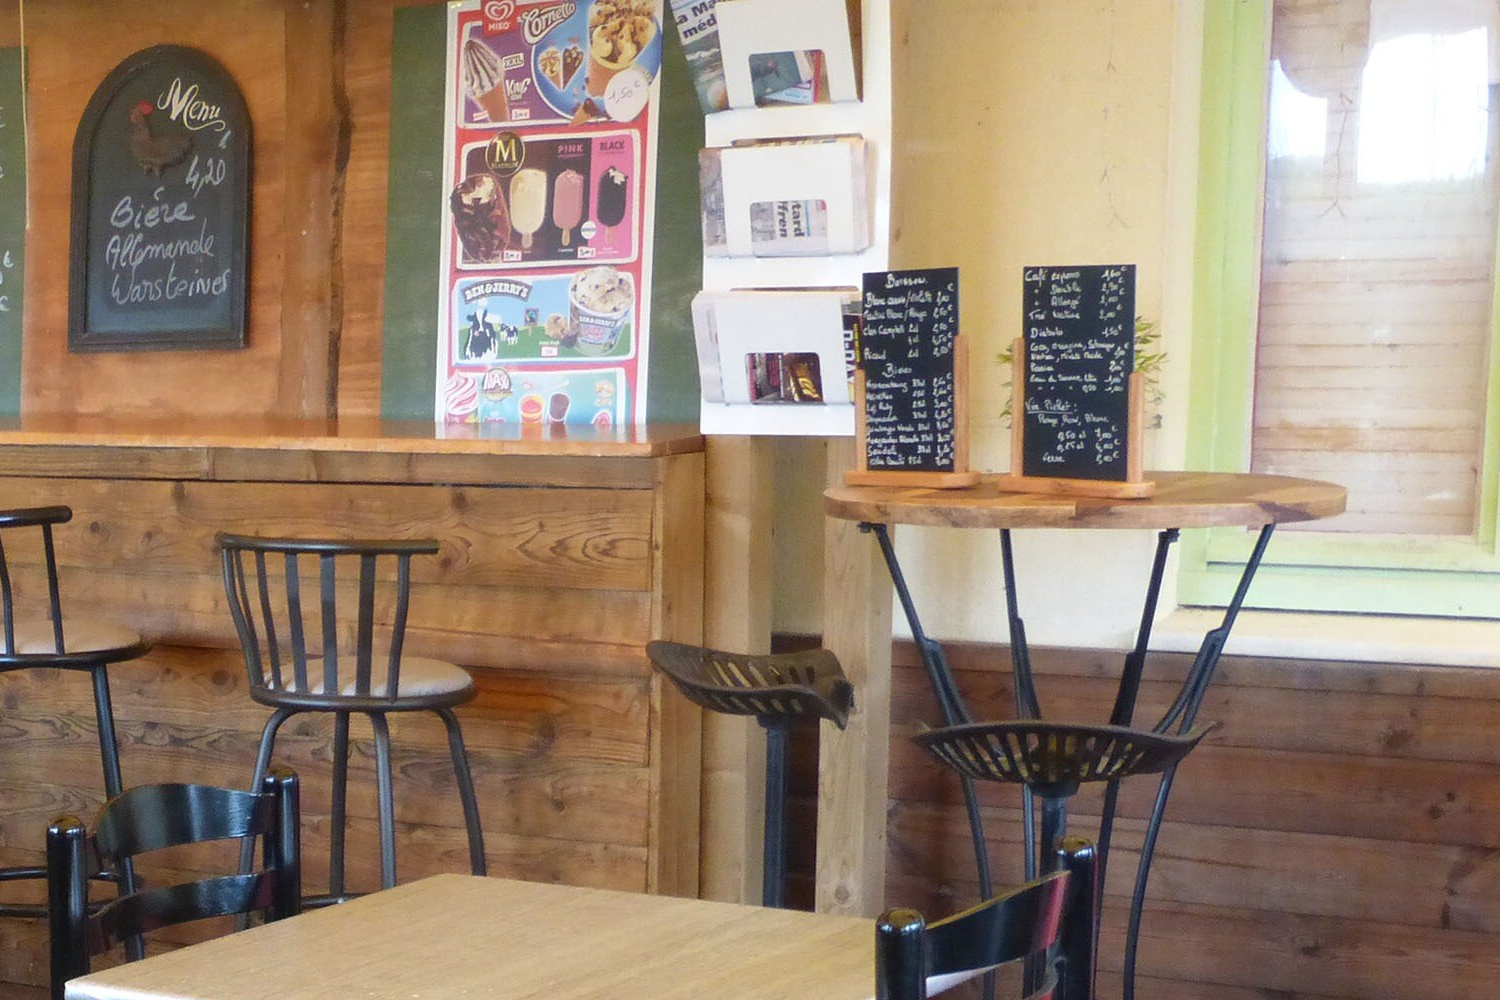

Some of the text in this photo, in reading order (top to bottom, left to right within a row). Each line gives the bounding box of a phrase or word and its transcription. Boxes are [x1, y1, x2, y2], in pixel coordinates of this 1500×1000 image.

[488, 22, 511, 31] MIKO
[521, 2, 576, 45] Cornetto
[504, 55, 523, 67] XXL
[157, 77, 225, 131] Menu
[496, 140, 517, 162] M
[557, 144, 584, 154] PINK
[600, 140, 625, 151] BLACK
[791, 200, 805, 238] tard
